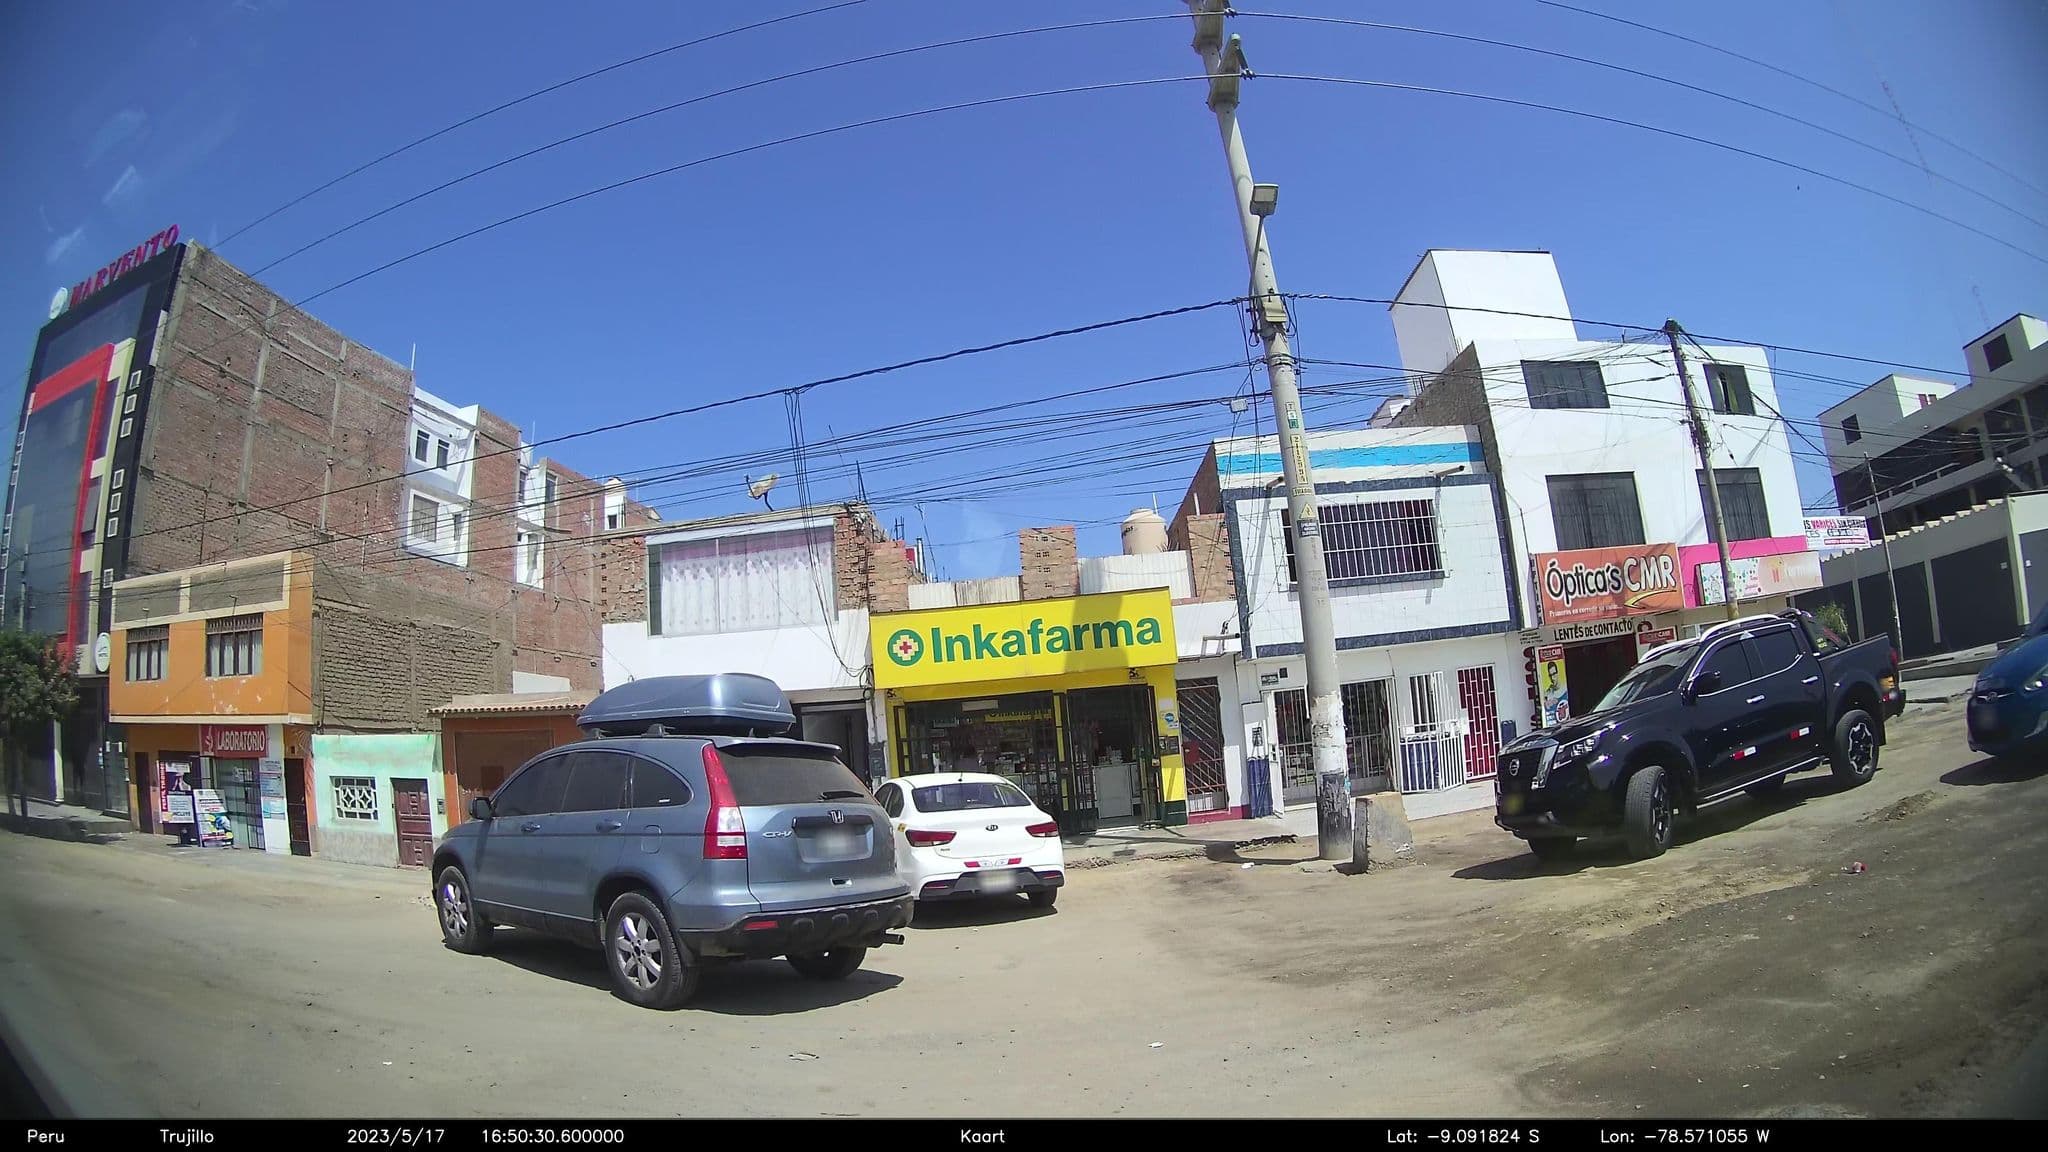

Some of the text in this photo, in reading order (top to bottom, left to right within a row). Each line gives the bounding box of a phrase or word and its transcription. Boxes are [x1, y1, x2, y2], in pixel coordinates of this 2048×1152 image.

[1811, 519, 1837, 529] VARICES
[1623, 554, 1676, 591] CMR
[931, 617, 1162, 663] Inkafarma
[1554, 625, 1585, 641] LENTES
[1585, 627, 1593, 638] DE
[1594, 620, 1633, 635] CONTACTO
[217, 730, 265, 751] LABORATORIO
